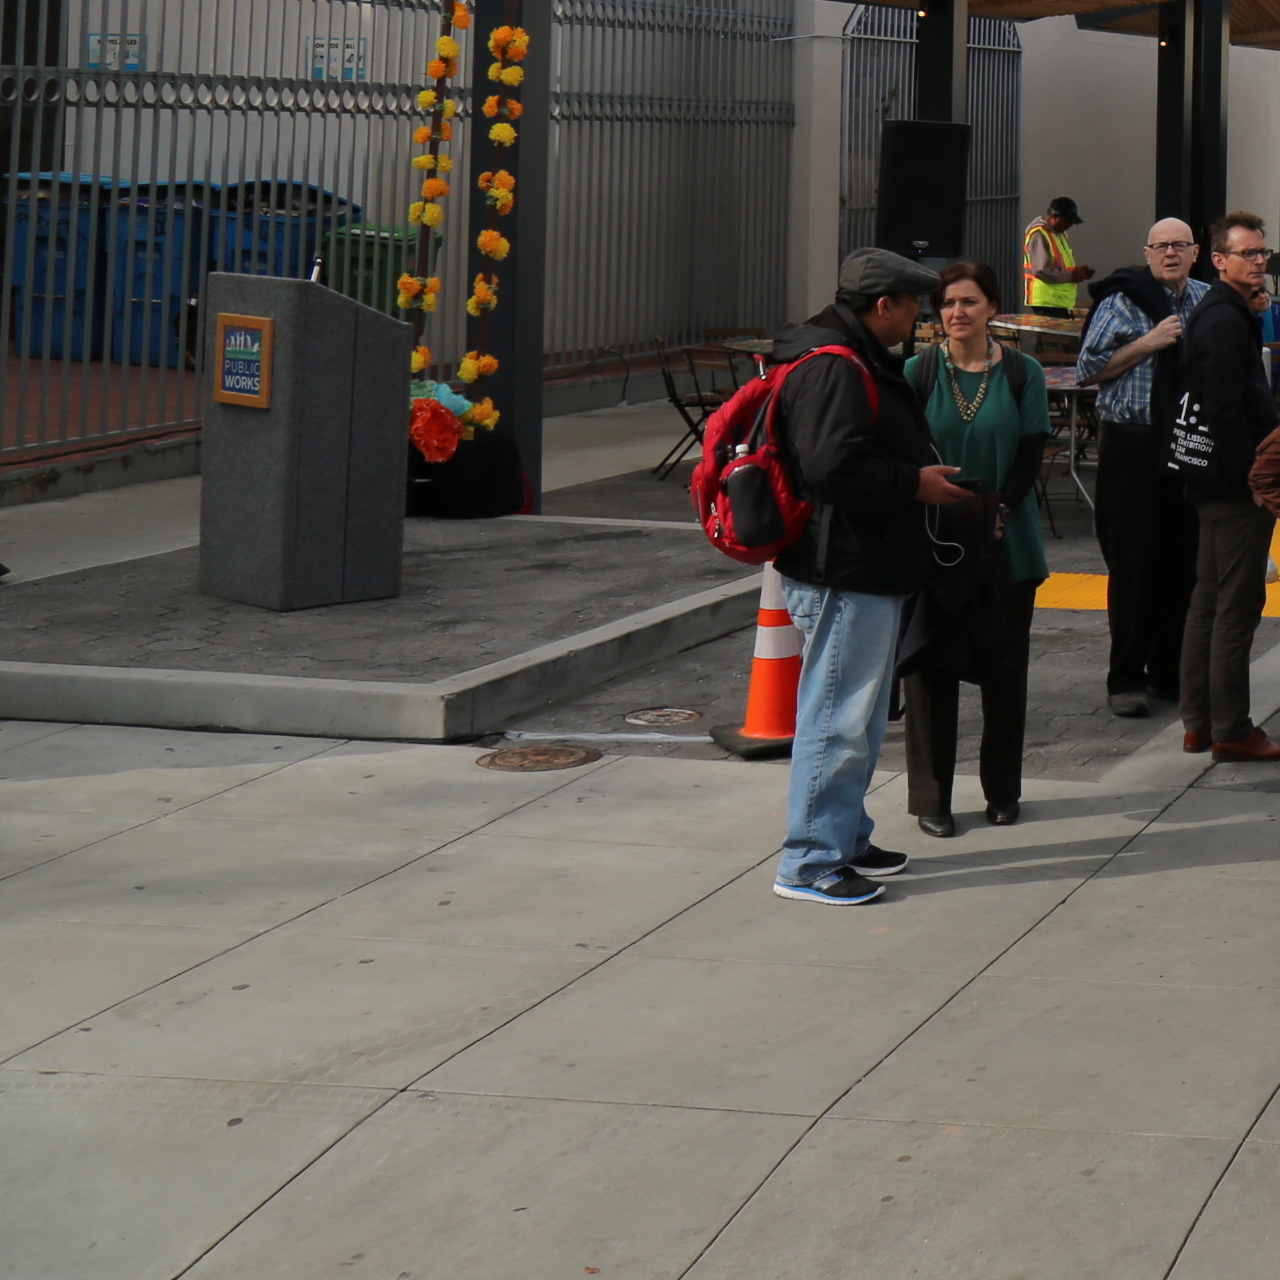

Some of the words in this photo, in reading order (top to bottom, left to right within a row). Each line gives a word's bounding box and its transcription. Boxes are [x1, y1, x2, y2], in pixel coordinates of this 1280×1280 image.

[225, 360, 260, 375] PUBLIC
[225, 375, 260, 391] WORKS
[1174, 451, 1208, 467] FRANCISCO
